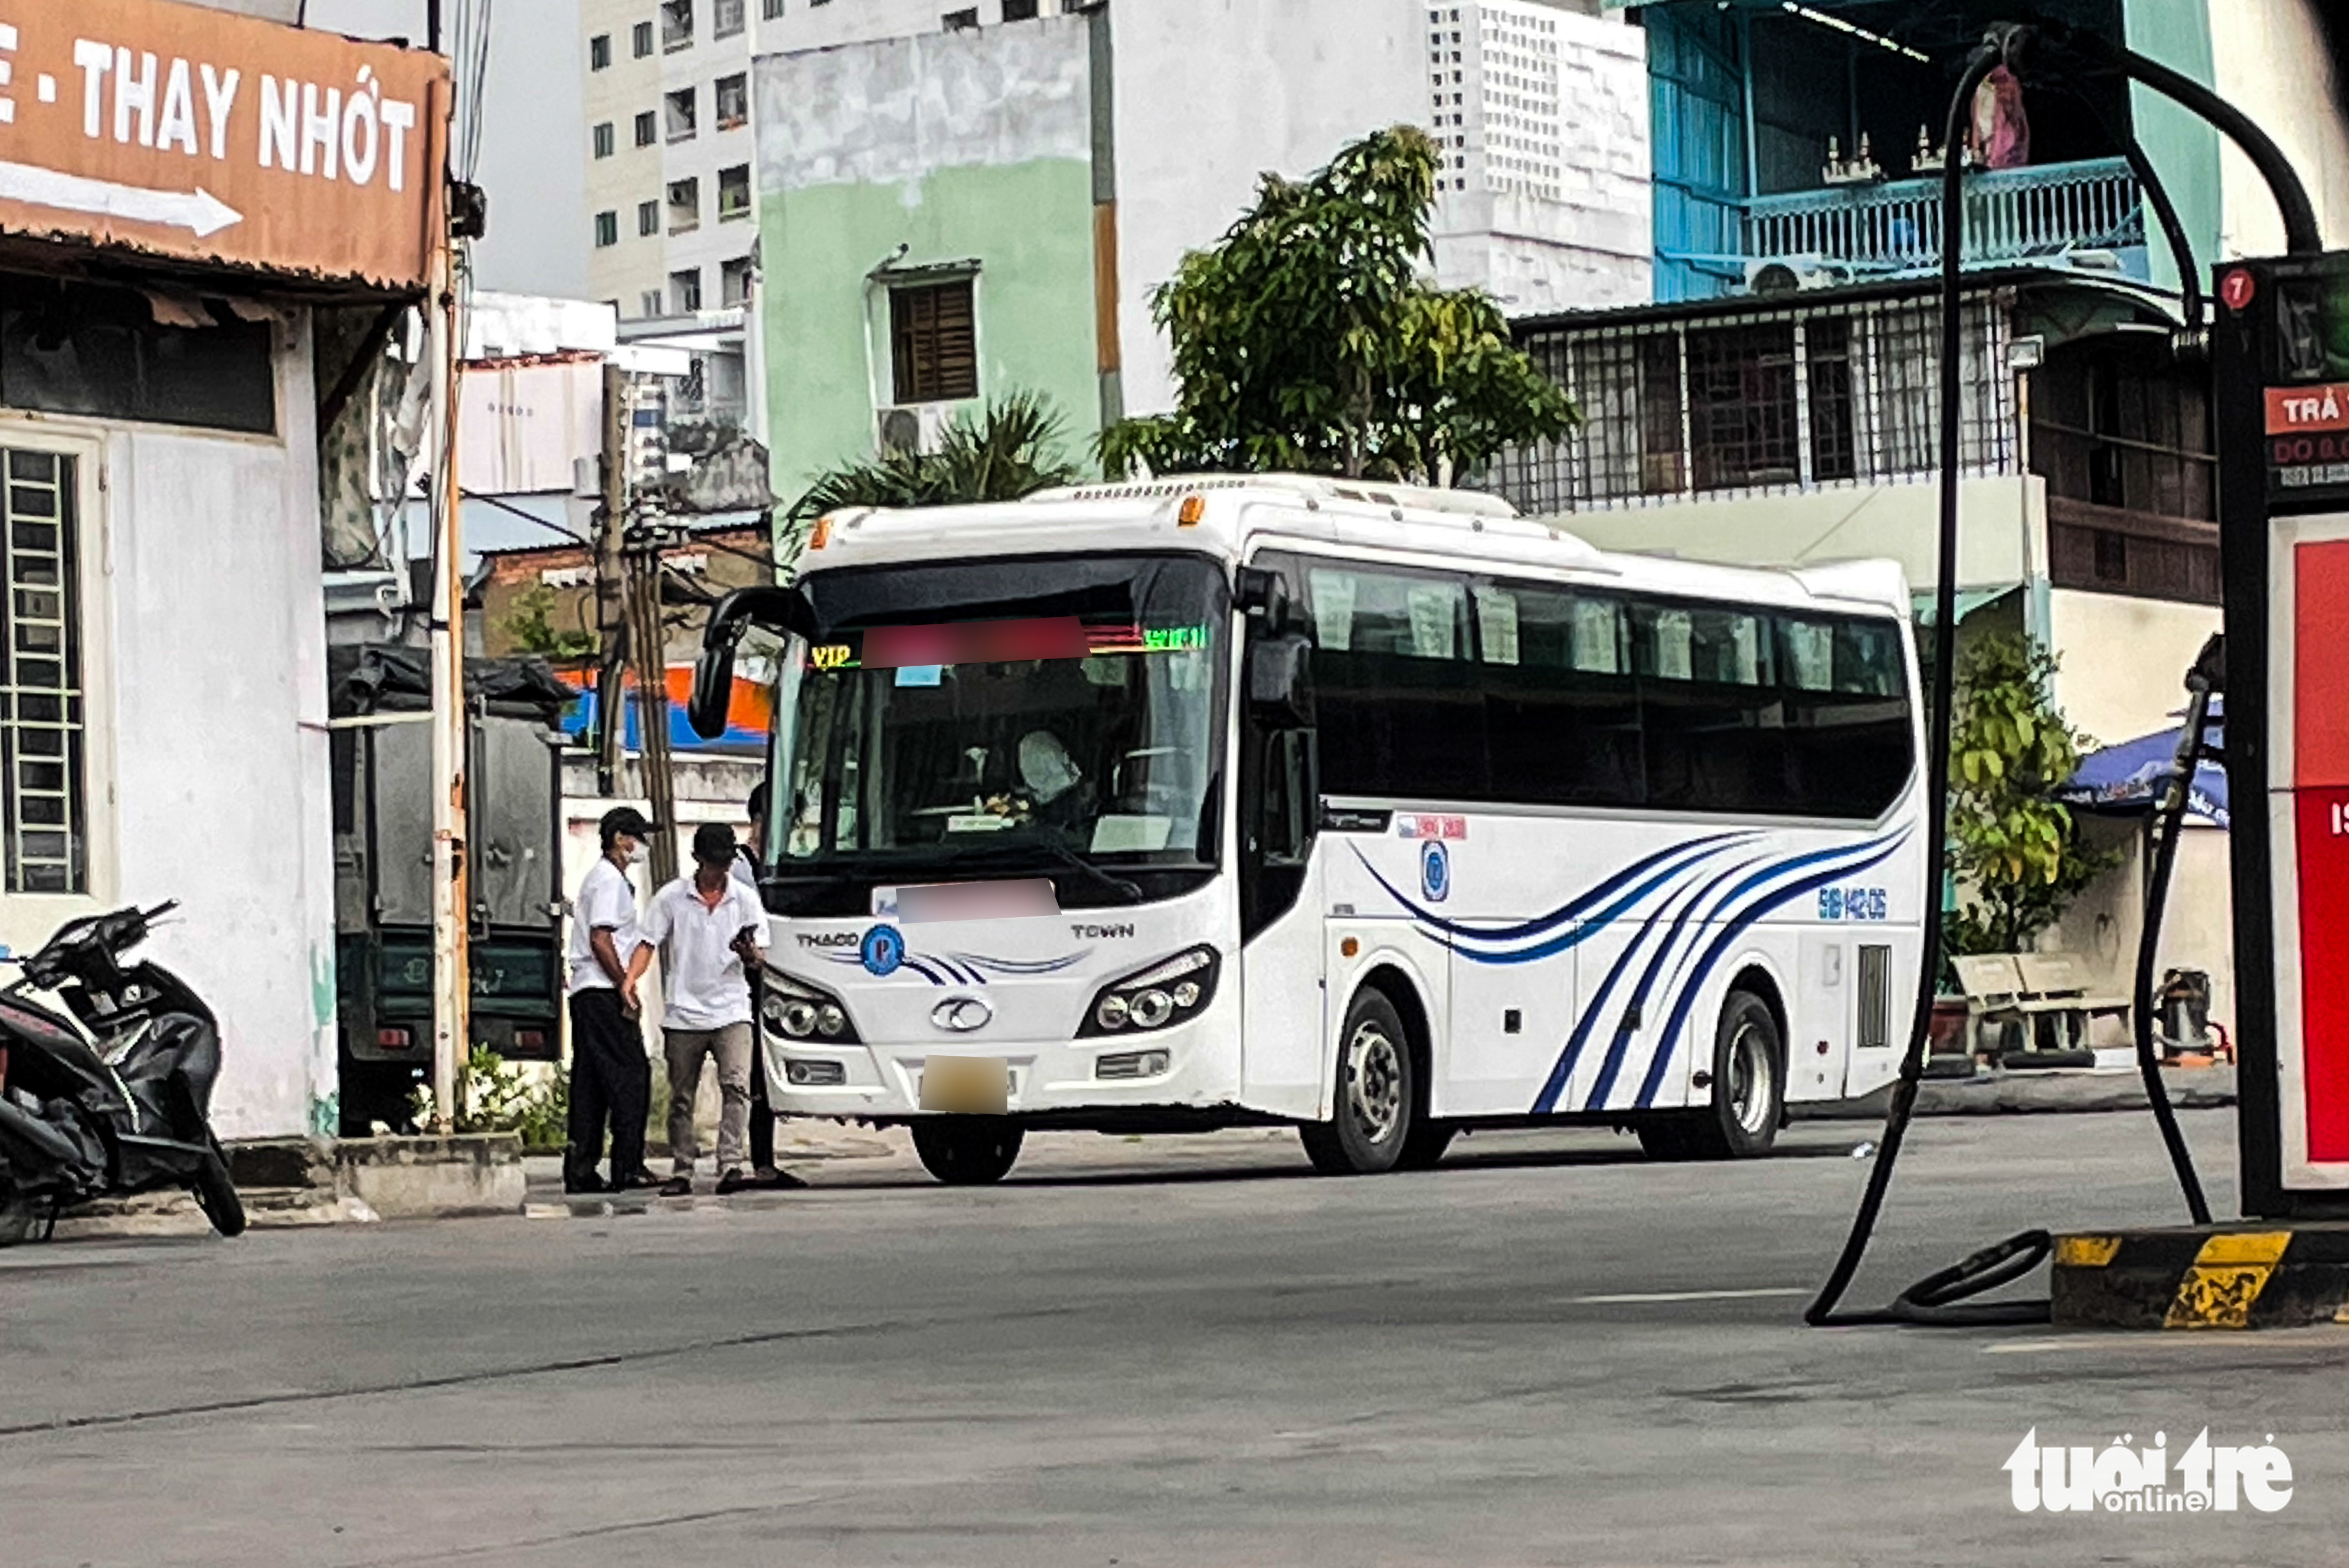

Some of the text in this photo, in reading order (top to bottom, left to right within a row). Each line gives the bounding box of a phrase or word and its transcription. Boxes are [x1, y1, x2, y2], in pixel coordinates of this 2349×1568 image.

[75, 38, 240, 160] THAY
[258, 64, 415, 192] NHỚT
[2282, 387, 2340, 423] TRẢ
[812, 645, 851, 667] VIP
[796, 932, 859, 948] THACO
[1071, 924, 1135, 940] TOWN
